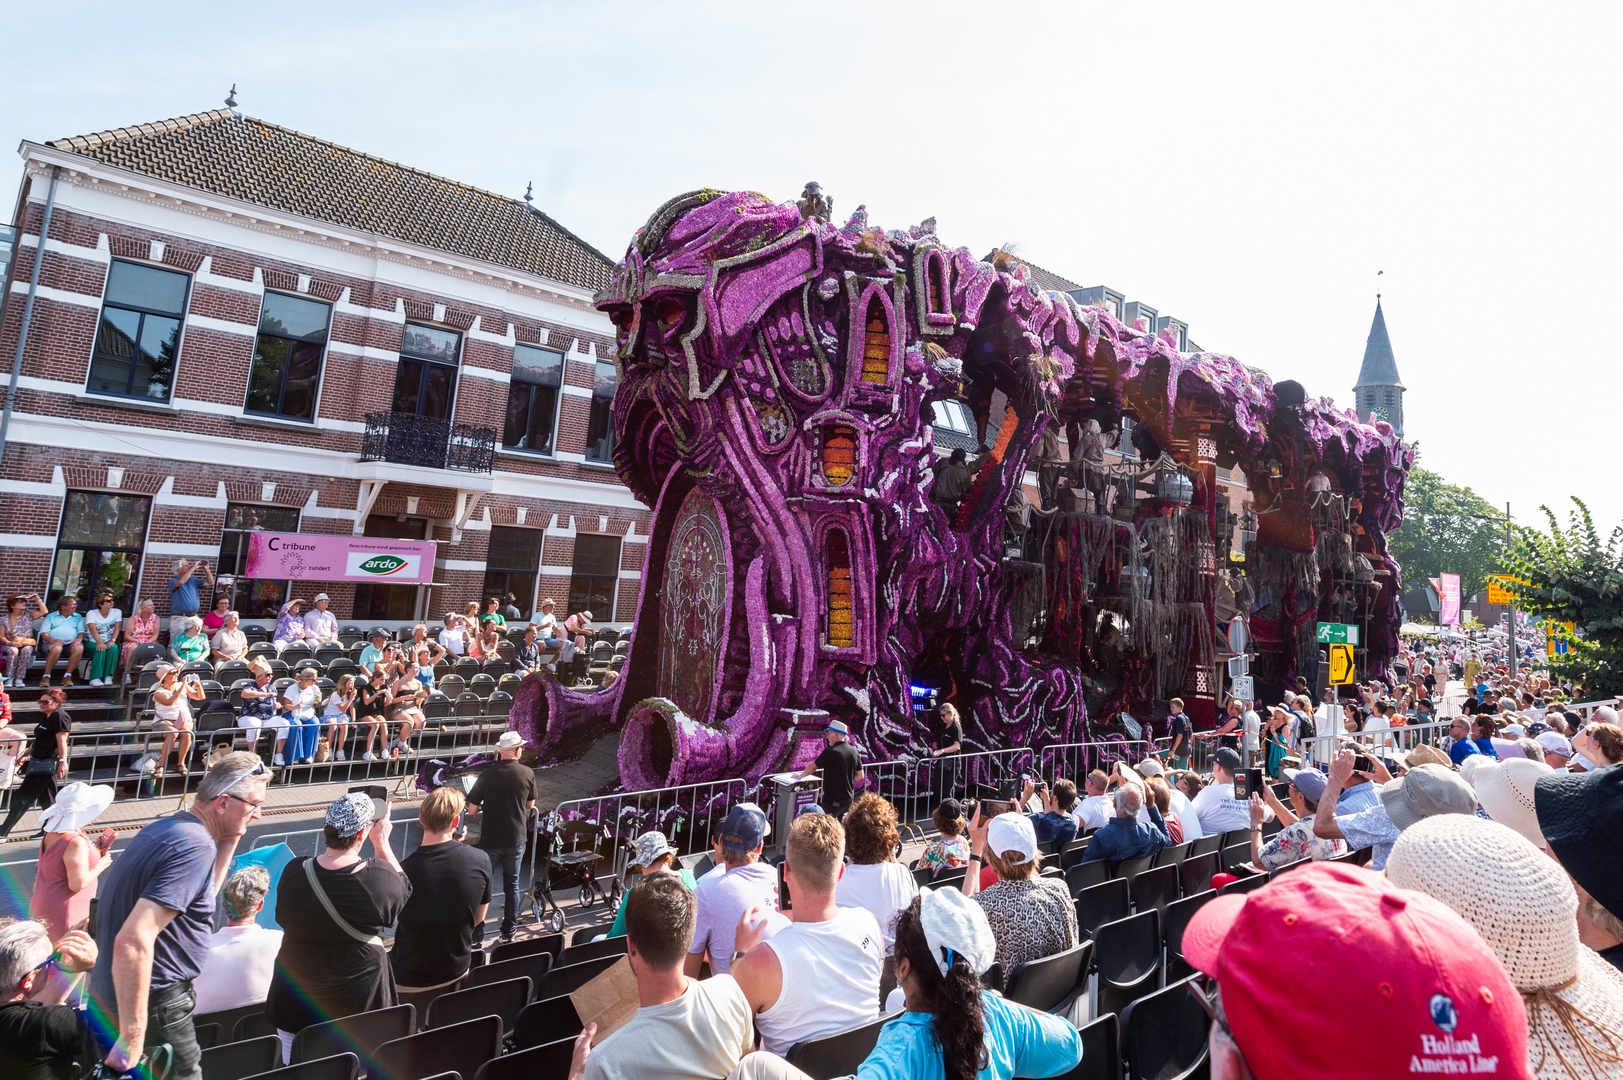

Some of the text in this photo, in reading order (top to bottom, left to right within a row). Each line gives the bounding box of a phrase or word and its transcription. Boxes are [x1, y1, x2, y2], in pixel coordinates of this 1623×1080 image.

[268, 537, 316, 551] C tribune
[365, 559, 397, 569] ardo
[1333, 656, 1344, 672] UIT
[1236, 786, 1246, 796] 50
[861, 937, 870, 950] 29
[1420, 1032, 1481, 1055] Holland
[1409, 1054, 1468, 1074] America
